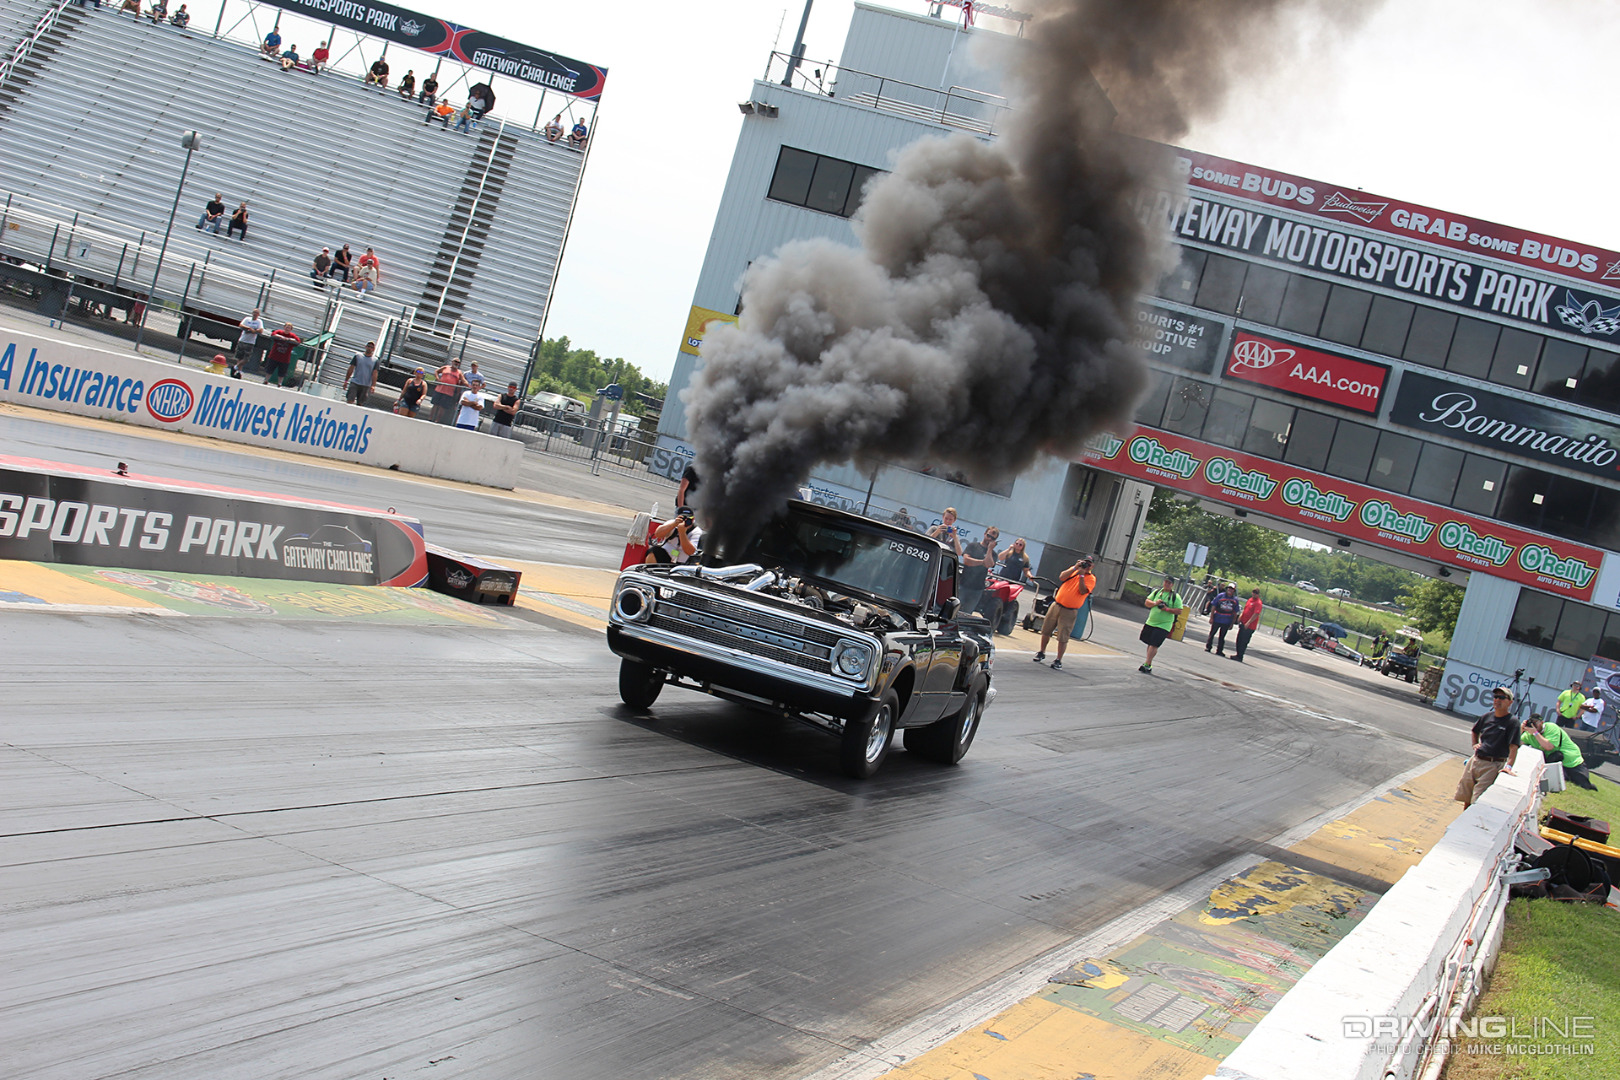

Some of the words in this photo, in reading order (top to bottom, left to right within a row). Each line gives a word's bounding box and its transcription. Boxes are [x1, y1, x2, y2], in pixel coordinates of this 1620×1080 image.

[366, 8, 399, 31] PARK
[472, 50, 521, 76] GATEWAY
[520, 64, 577, 92] CHALLENGE
[1192, 166, 1241, 188] SOME
[1241, 172, 1316, 205] BUDS
[1323, 194, 1383, 217] Budweiser
[1390, 209, 1468, 242] GRAB
[1468, 233, 1519, 255] SOME
[1520, 239, 1599, 273] BUDS
[1262, 218, 1471, 301] MOTORSPORTS
[1473, 268, 1557, 323] PARK
[1137, 311, 1185, 332] OURI'S
[1188, 323, 1205, 337] #1
[1237, 342, 1270, 367] AAA
[18, 348, 144, 413] Insurance
[1289, 362, 1379, 399] AAA.com
[152, 385, 188, 416] NHRA
[192, 384, 287, 439] Midwest
[283, 402, 373, 454] Nationals
[1418, 392, 1618, 466] Bommarito
[1131, 438, 1199, 477] O'Reilly
[1146, 467, 1160, 476] AUTO
[1160, 471, 1177, 480] PARTS
[809, 483, 840, 500] harter
[1207, 459, 1275, 498] O'Reilly
[1222, 488, 1236, 496] AUTO
[1236, 492, 1254, 501] PARTS
[1284, 481, 1353, 519] O'Reilly
[1299, 509, 1314, 518] AUTO
[1314, 513, 1332, 523] PARTS
[179, 515, 285, 561] PARK
[1362, 502, 1433, 540] O'Reilly
[1378, 531, 1393, 540] AUTO
[1393, 535, 1411, 544] PARTS
[283, 545, 326, 570] GATEWAY
[326, 549, 374, 574] CHALLENGE
[889, 541, 905, 554] PS
[906, 543, 930, 562] 6249
[1441, 524, 1512, 563] O'Reilly
[1456, 553, 1471, 562] AUTO
[1471, 557, 1490, 567] PARTS
[1521, 546, 1594, 585] O'Reilly
[1537, 575, 1552, 584] AUTO
[1552, 579, 1571, 589] PARTS
[684, 612, 798, 647] CHEVROLET
